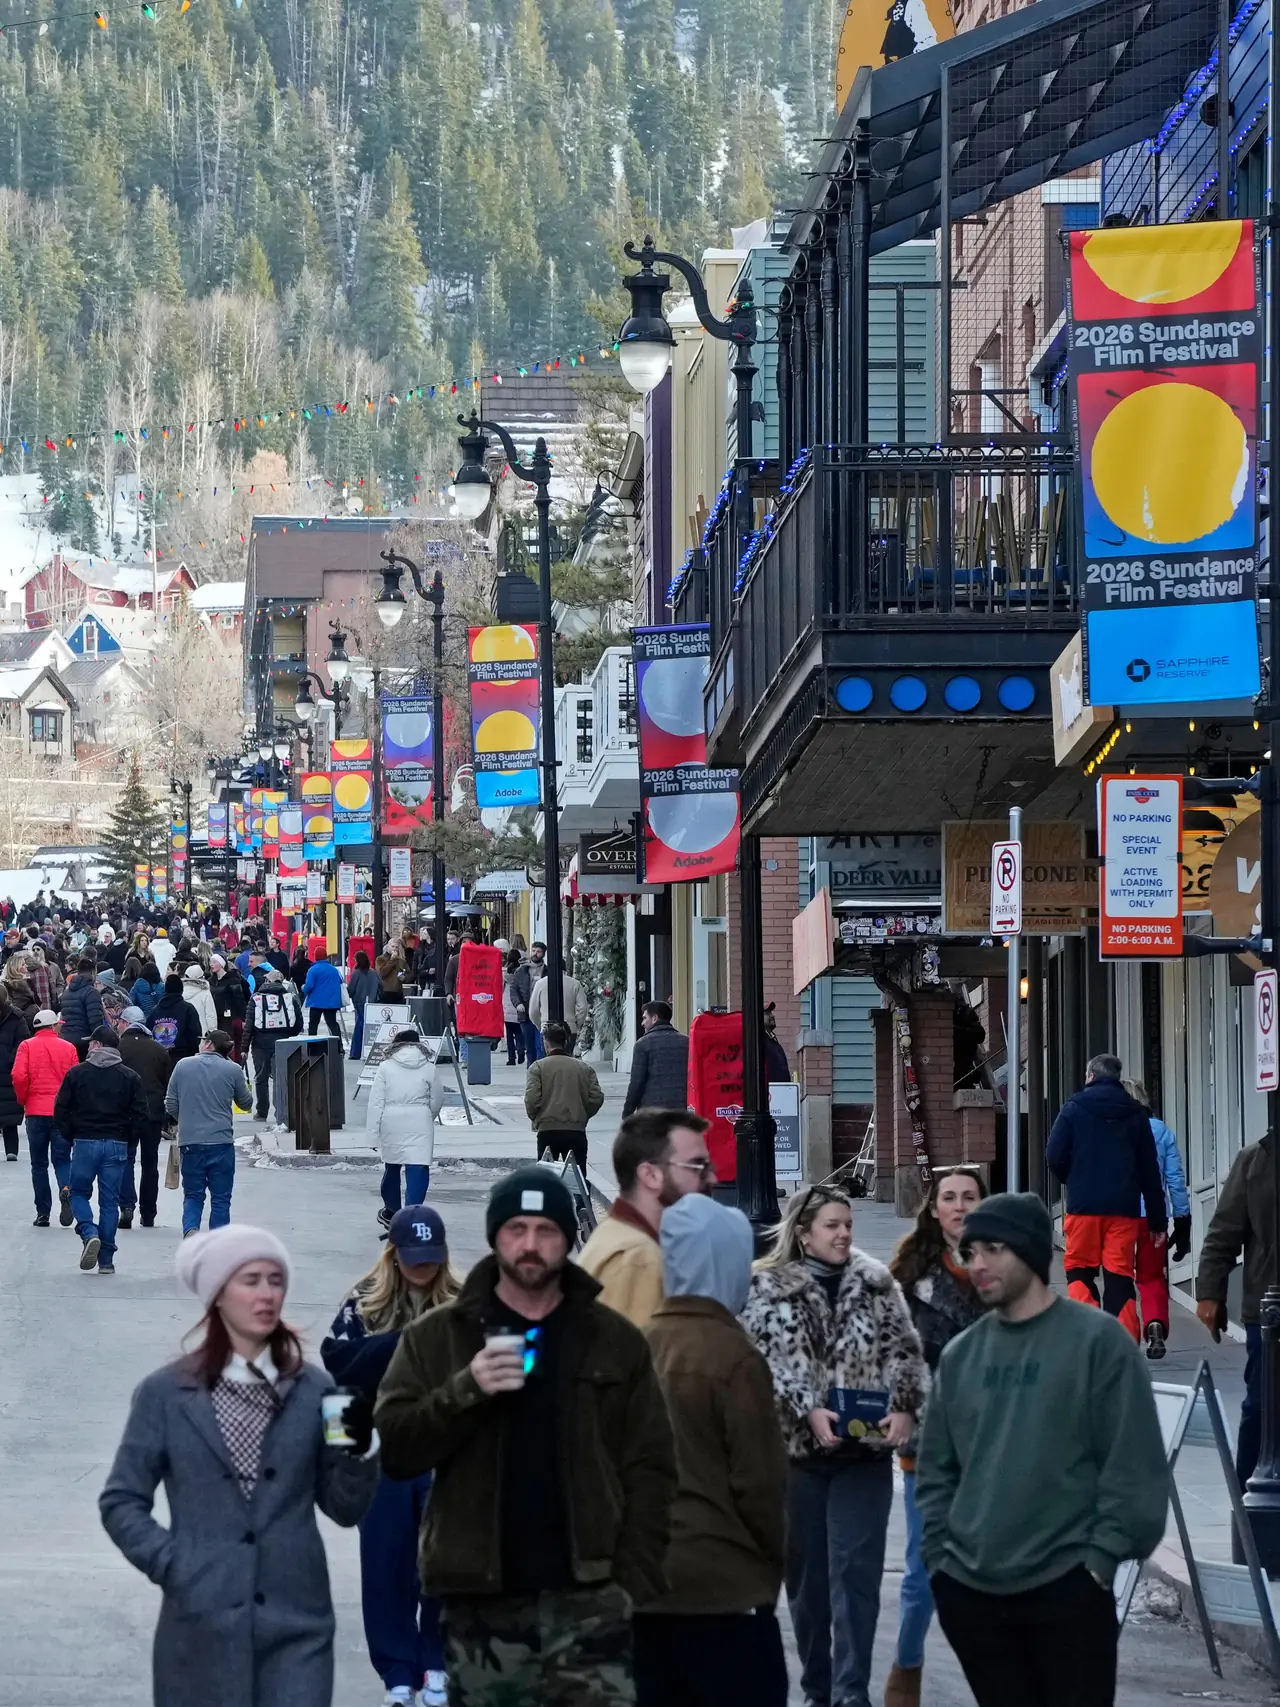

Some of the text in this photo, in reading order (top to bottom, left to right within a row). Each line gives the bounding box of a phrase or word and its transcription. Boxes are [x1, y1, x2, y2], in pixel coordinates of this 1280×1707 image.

[1065, 277, 1074, 351] festival.sundance.org
[1075, 319, 1255, 347] 2026 Sundance
[1094, 338, 1238, 366] Film Festival
[1086, 557, 1254, 584] 2026 Sundance
[1105, 575, 1242, 603] Film Festival
[636, 630, 710, 646] 2026 Sunda
[645, 642, 710, 656] Film Festiv
[470, 662, 538, 673] 2026 Sundance
[1156, 656, 1230, 669] SAPPHIRE
[477, 669, 532, 680] Film Festival
[1157, 670, 1209, 679] RESERVE
[474, 751, 537, 763] 2026 Sundance
[481, 759, 533, 770] Film Festival
[643, 768, 739, 783] 2026 Sundance
[653, 778, 730, 793] Film Festival
[495, 788, 522, 797] Adobe
[1113, 814, 1172, 823] NO PARKING
[1122, 836, 1161, 844] SPECIAL
[586, 850, 636, 862] OVER
[1126, 846, 1157, 855] EVENT
[673, 855, 714, 868] Adobe
[833, 869, 941, 886] DEER VALL
[965, 865, 1077, 883] PICONE
[1123, 868, 1158, 876] ACTIVE
[1121, 878, 1163, 887] LOADING
[1002, 893, 1010, 904] NO
[1110, 889, 1173, 898] WITH PERMIT
[995, 904, 1017, 915] PARKING
[1128, 900, 1155, 908] ONLY
[1112, 925, 1171, 934] NO PARKING
[1108, 936, 1175, 945] 2:00-6:00 A.M.
[721, 1084, 742, 1094] EVEN
[412, 1222, 433, 1241] TB
